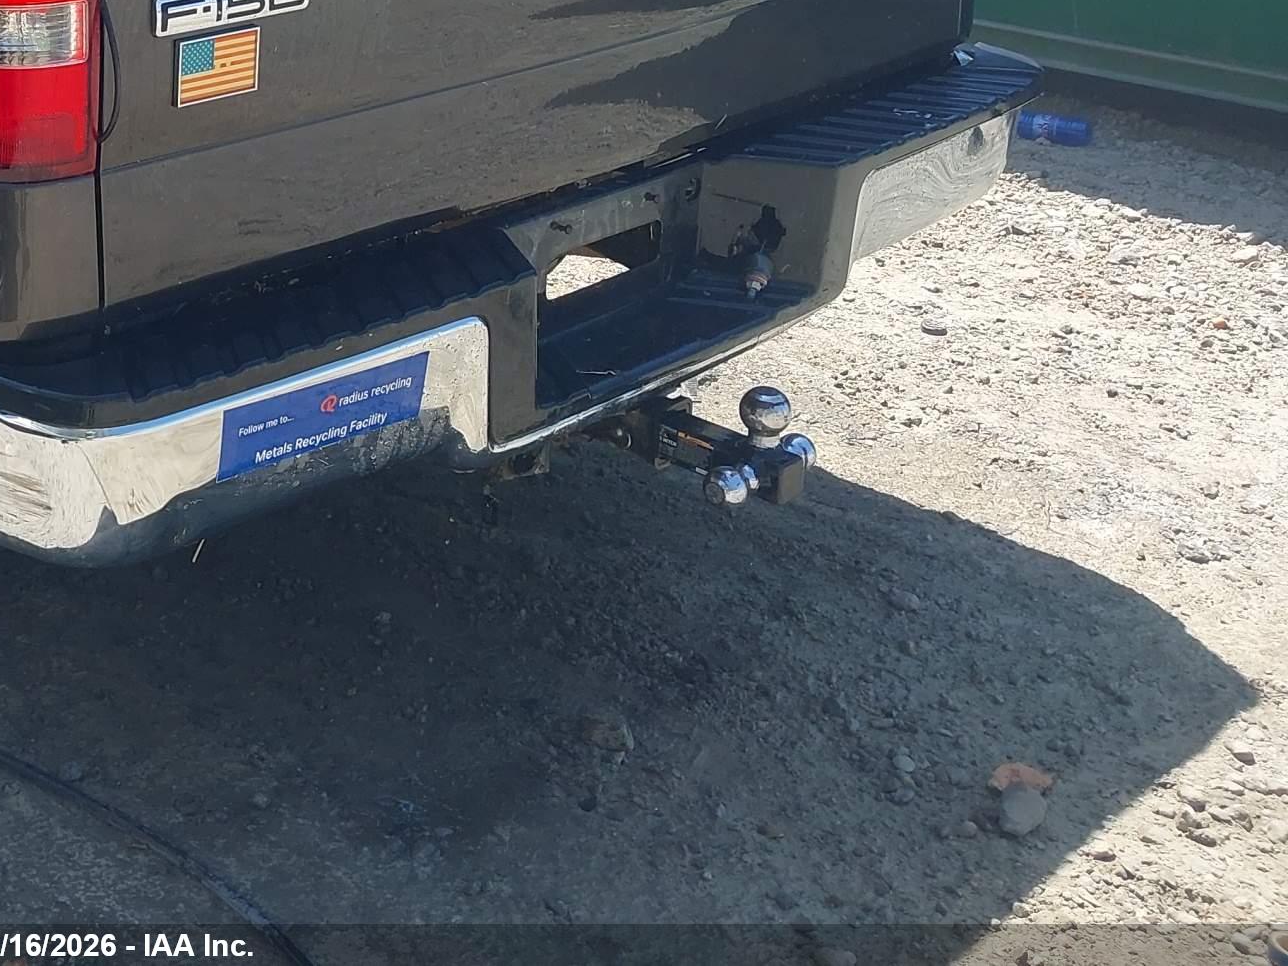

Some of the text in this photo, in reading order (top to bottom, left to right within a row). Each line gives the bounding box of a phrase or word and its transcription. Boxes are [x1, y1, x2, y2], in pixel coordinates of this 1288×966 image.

[338, 390, 369, 407] radius
[370, 376, 412, 397] recycling
[238, 422, 264, 437] Follow
[265, 419, 278, 429] me
[255, 411, 388, 464] Metals Recycling Facility
